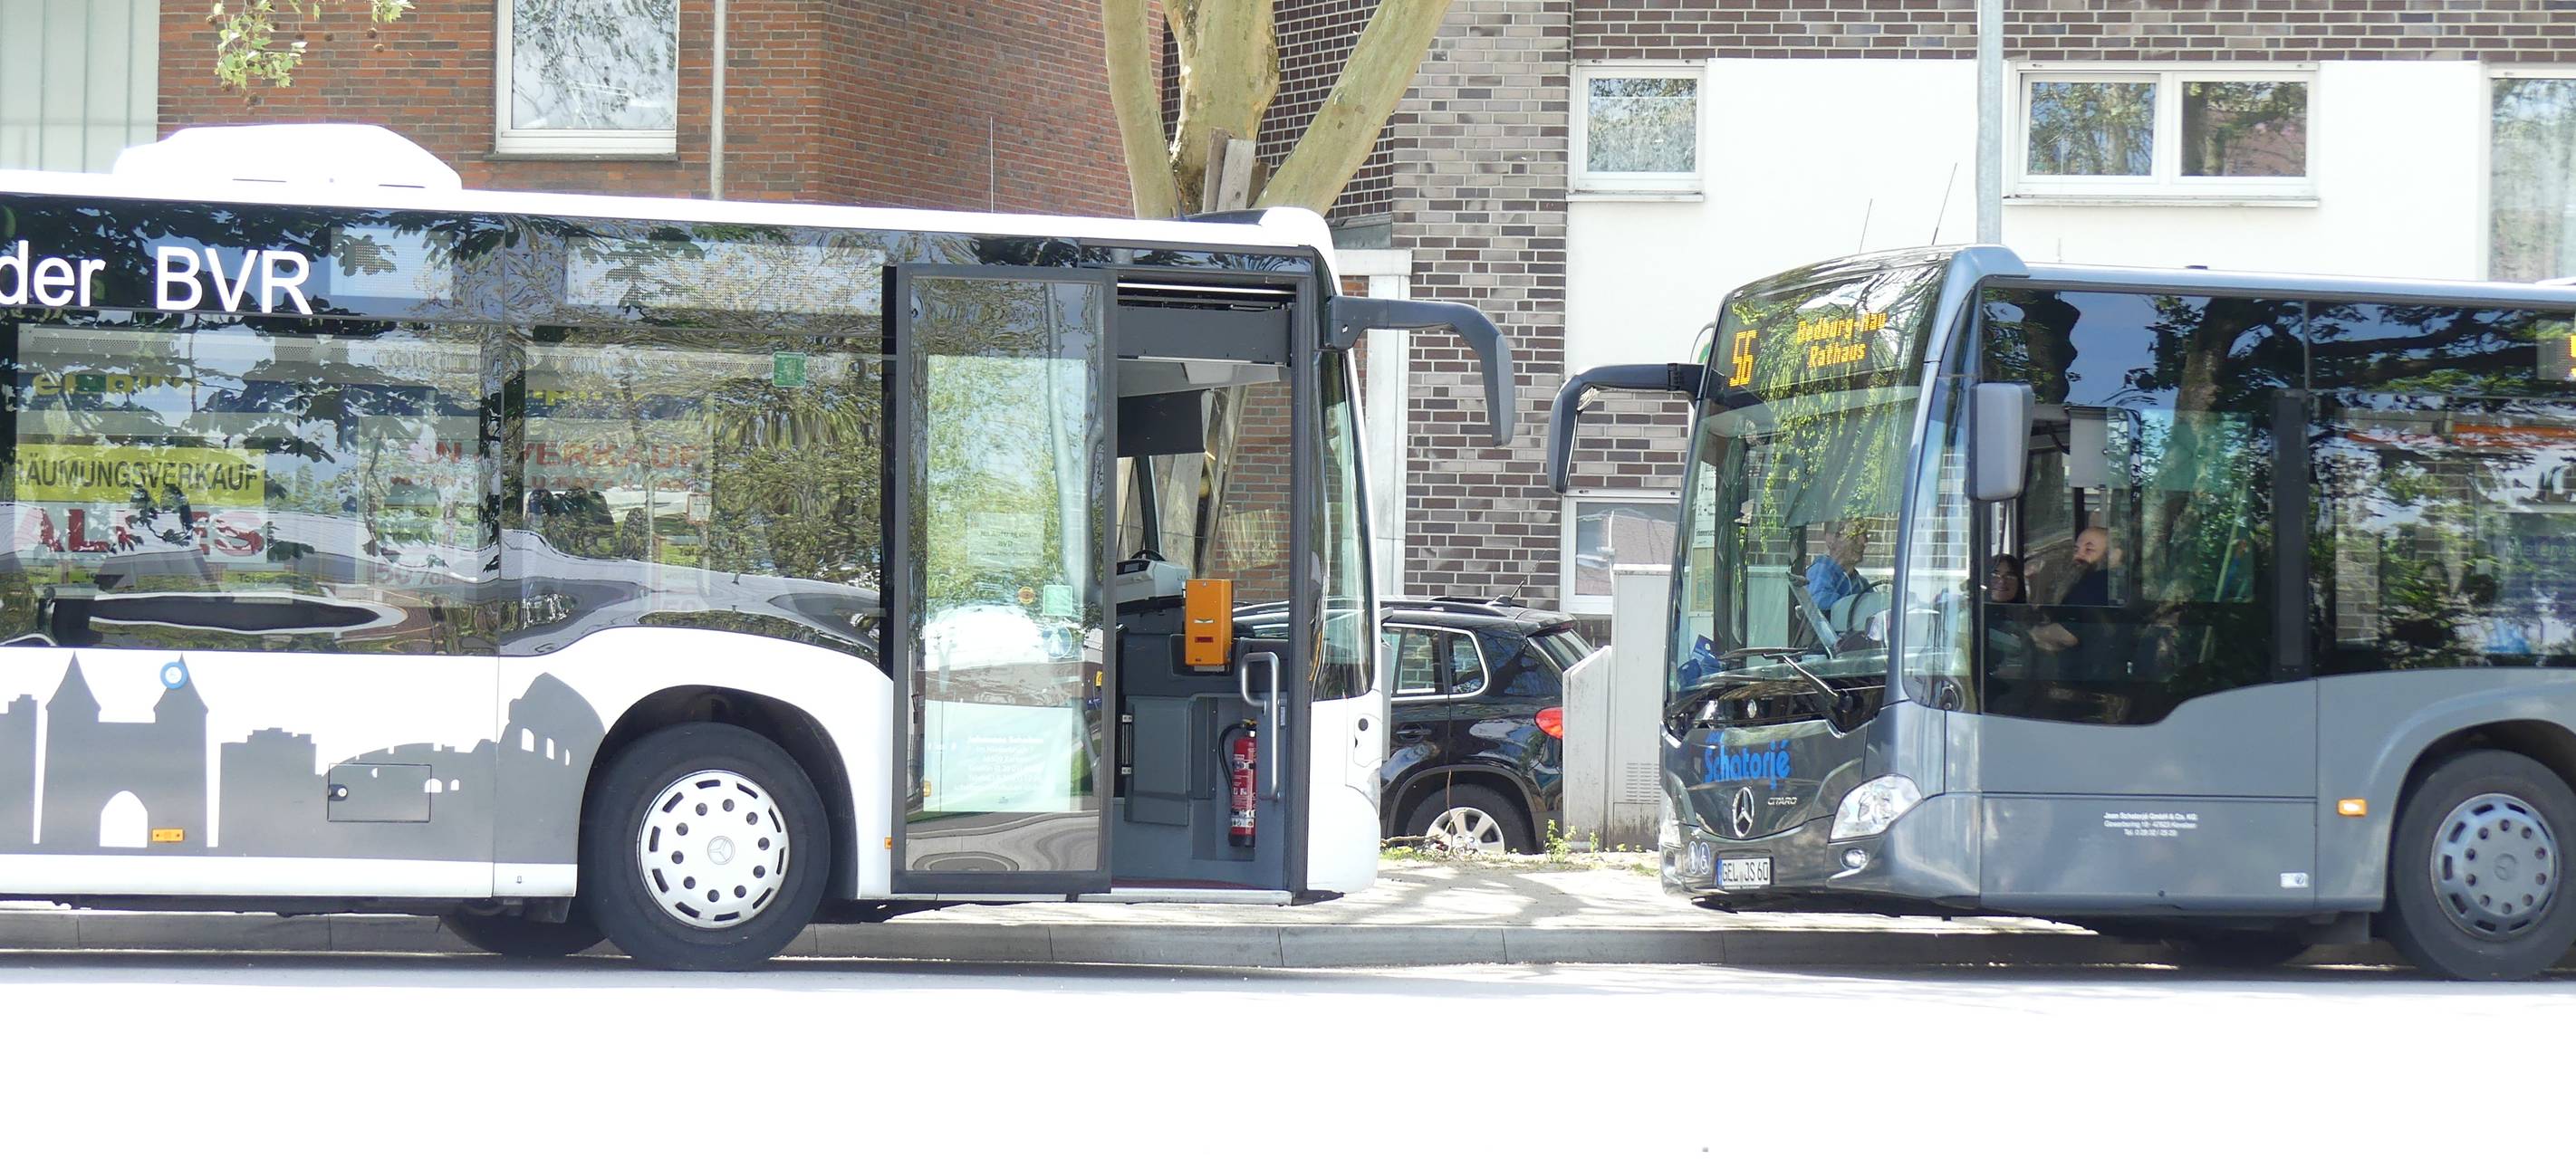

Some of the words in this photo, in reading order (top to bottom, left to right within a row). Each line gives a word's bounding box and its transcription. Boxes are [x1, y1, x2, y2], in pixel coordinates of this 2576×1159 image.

[0, 240, 106, 307] der
[156, 245, 313, 315] BVR
[1796, 312, 1888, 345] Bedburg-Hau
[1729, 330, 1758, 387] 56
[1807, 343, 1867, 369] Rathaus
[1705, 739, 1791, 790] Schatorjé
[1767, 797, 1797, 805] CITARO
[1723, 863, 1738, 881] GEL
[1745, 862, 1754, 881] JS
[1757, 862, 1768, 881] 60
